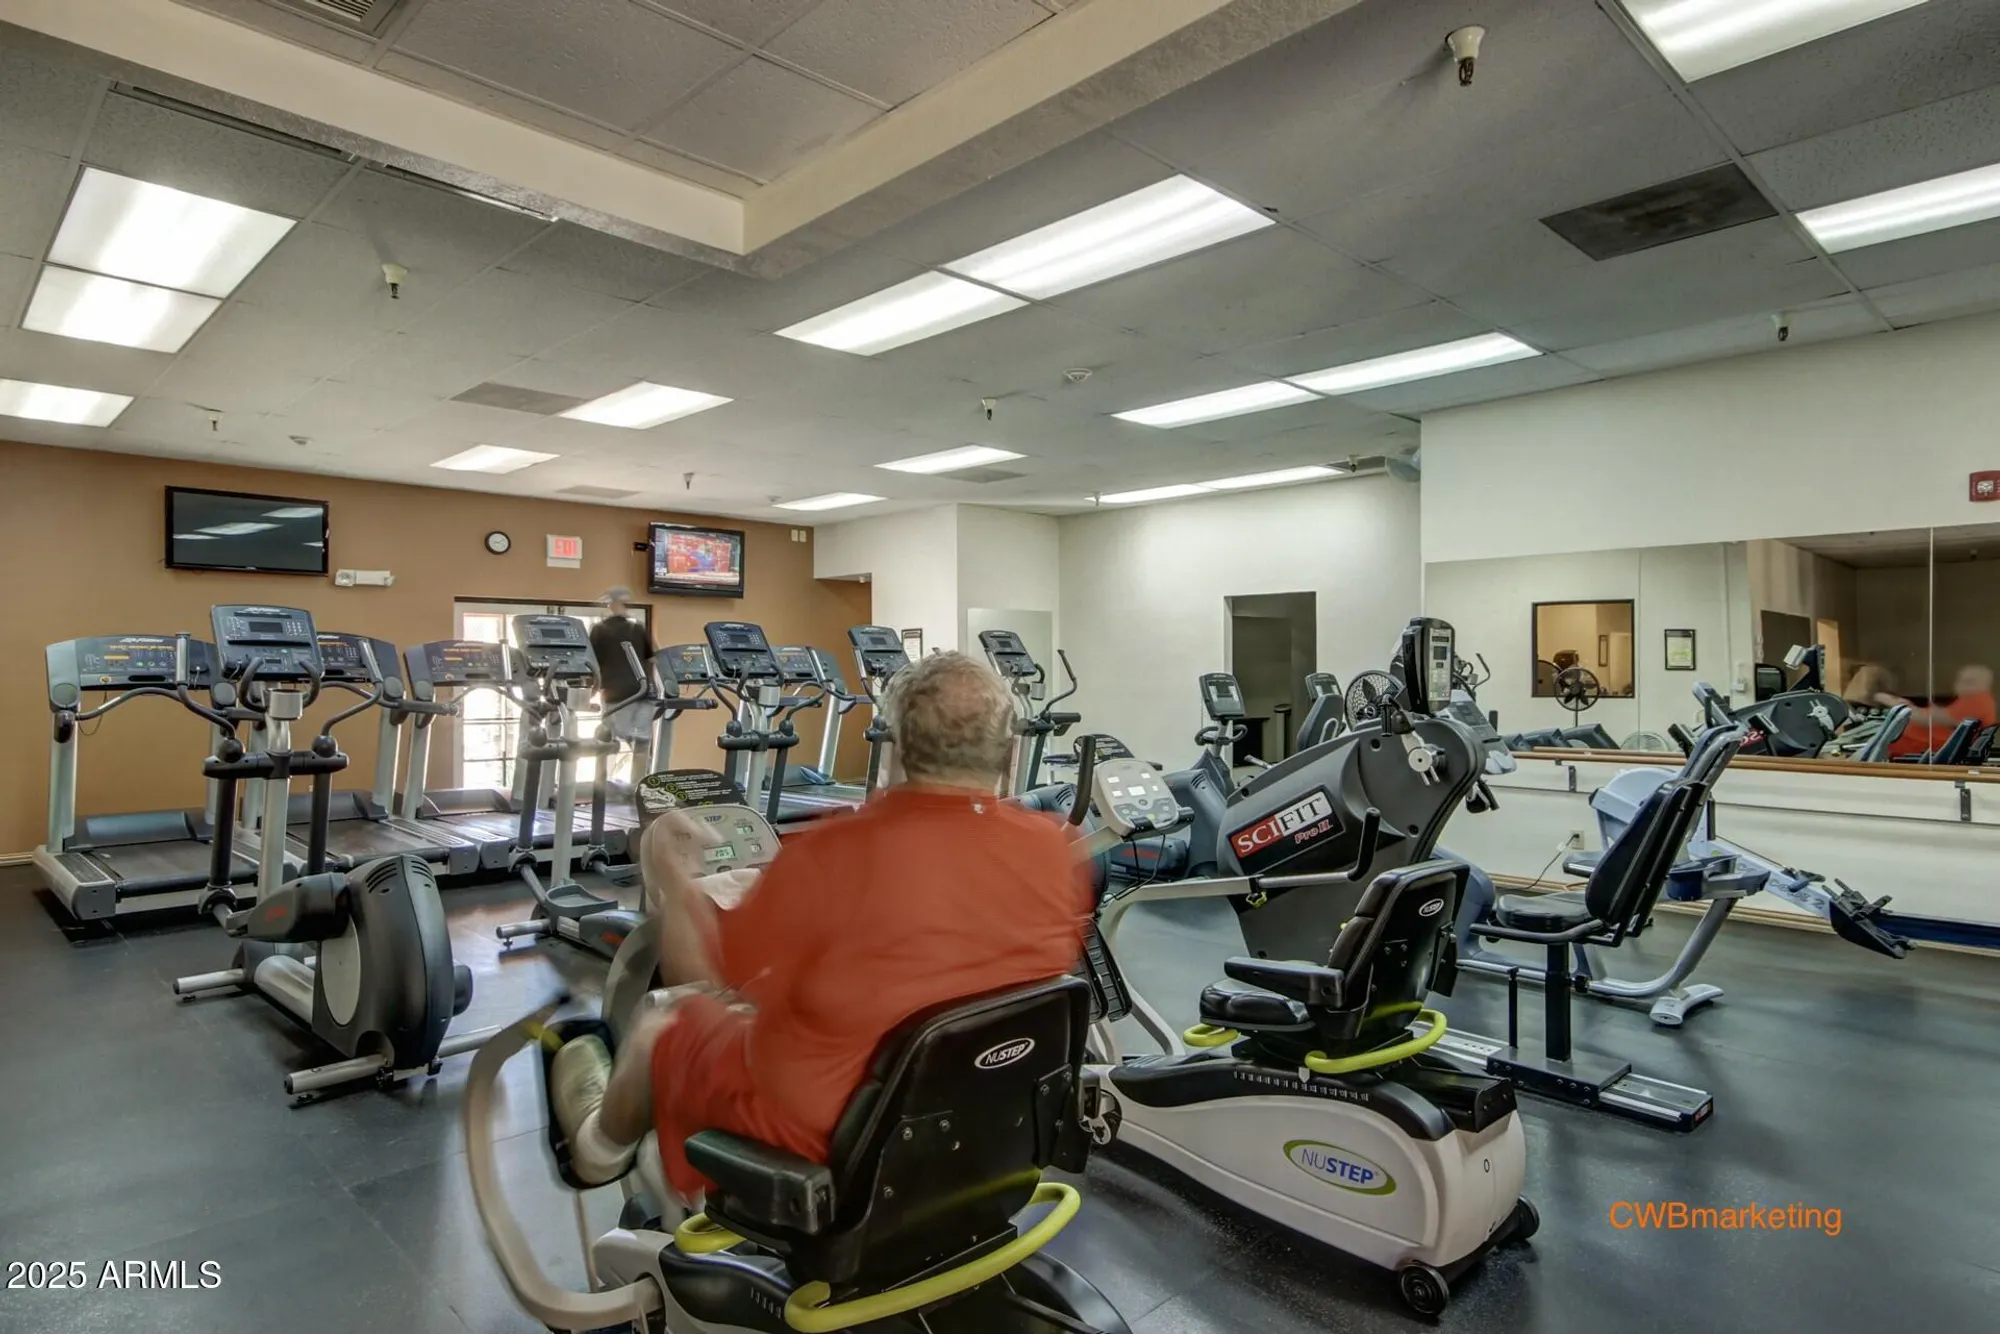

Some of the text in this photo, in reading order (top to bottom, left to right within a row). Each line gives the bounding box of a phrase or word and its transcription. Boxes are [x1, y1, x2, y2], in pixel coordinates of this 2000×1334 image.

[1238, 799, 1321, 853] SCIFIT
[985, 1044, 1026, 1065] NUSTEP
[1301, 1149, 1374, 1184] NUSTEP
